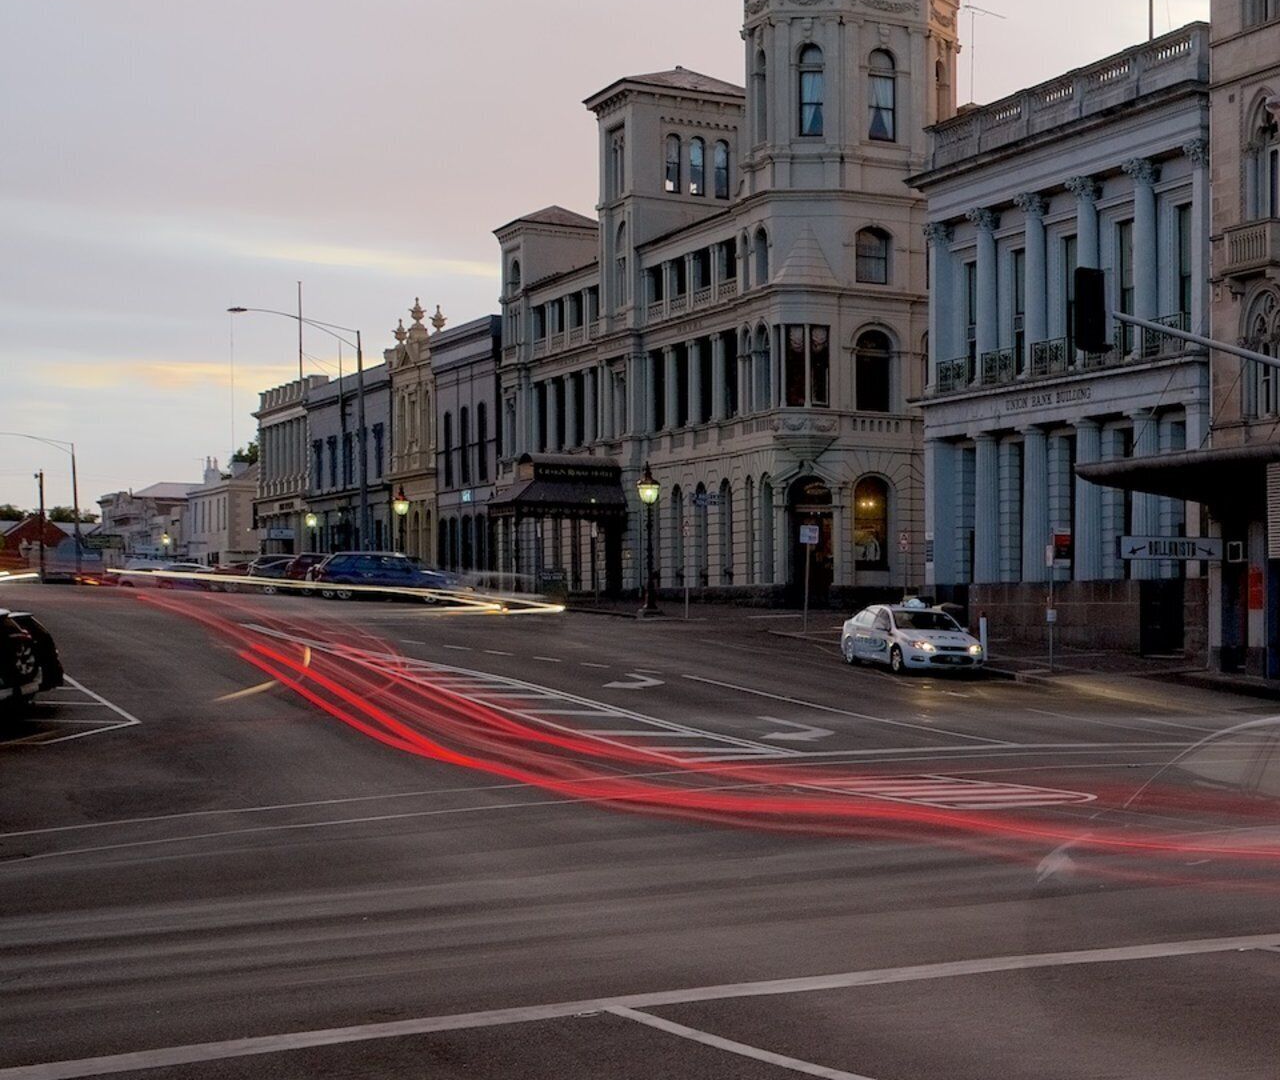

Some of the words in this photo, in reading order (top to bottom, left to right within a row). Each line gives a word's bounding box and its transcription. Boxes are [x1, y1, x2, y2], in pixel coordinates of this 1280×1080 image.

[1006, 396, 1029, 411] UNION
[1031, 393, 1053, 407] BANK
[1056, 387, 1091, 404] BUILDING
